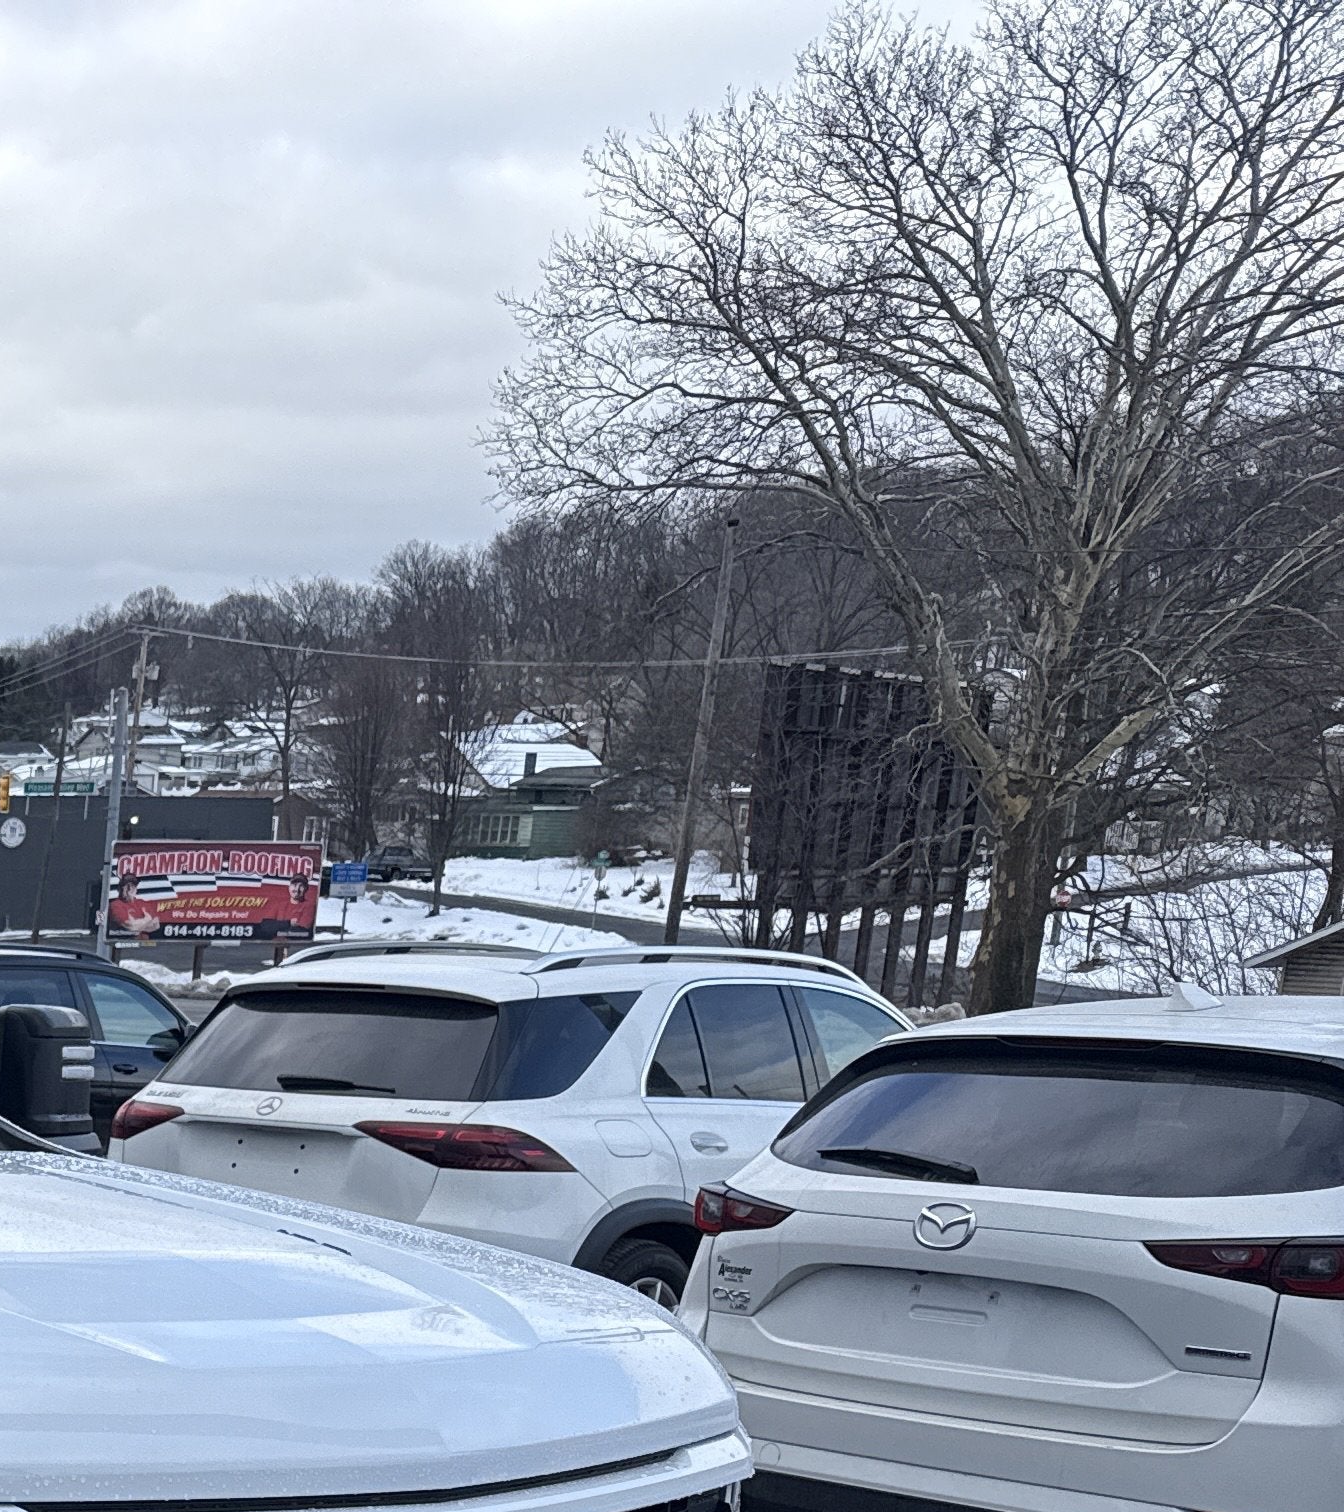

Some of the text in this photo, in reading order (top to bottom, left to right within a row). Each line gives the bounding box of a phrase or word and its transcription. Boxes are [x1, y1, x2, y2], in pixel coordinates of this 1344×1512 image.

[117, 850, 223, 877] CHAMPION
[228, 851, 313, 879] ROOFING
[206, 896, 268, 909] SOLUTION!
[199, 910, 230, 921] Repairs
